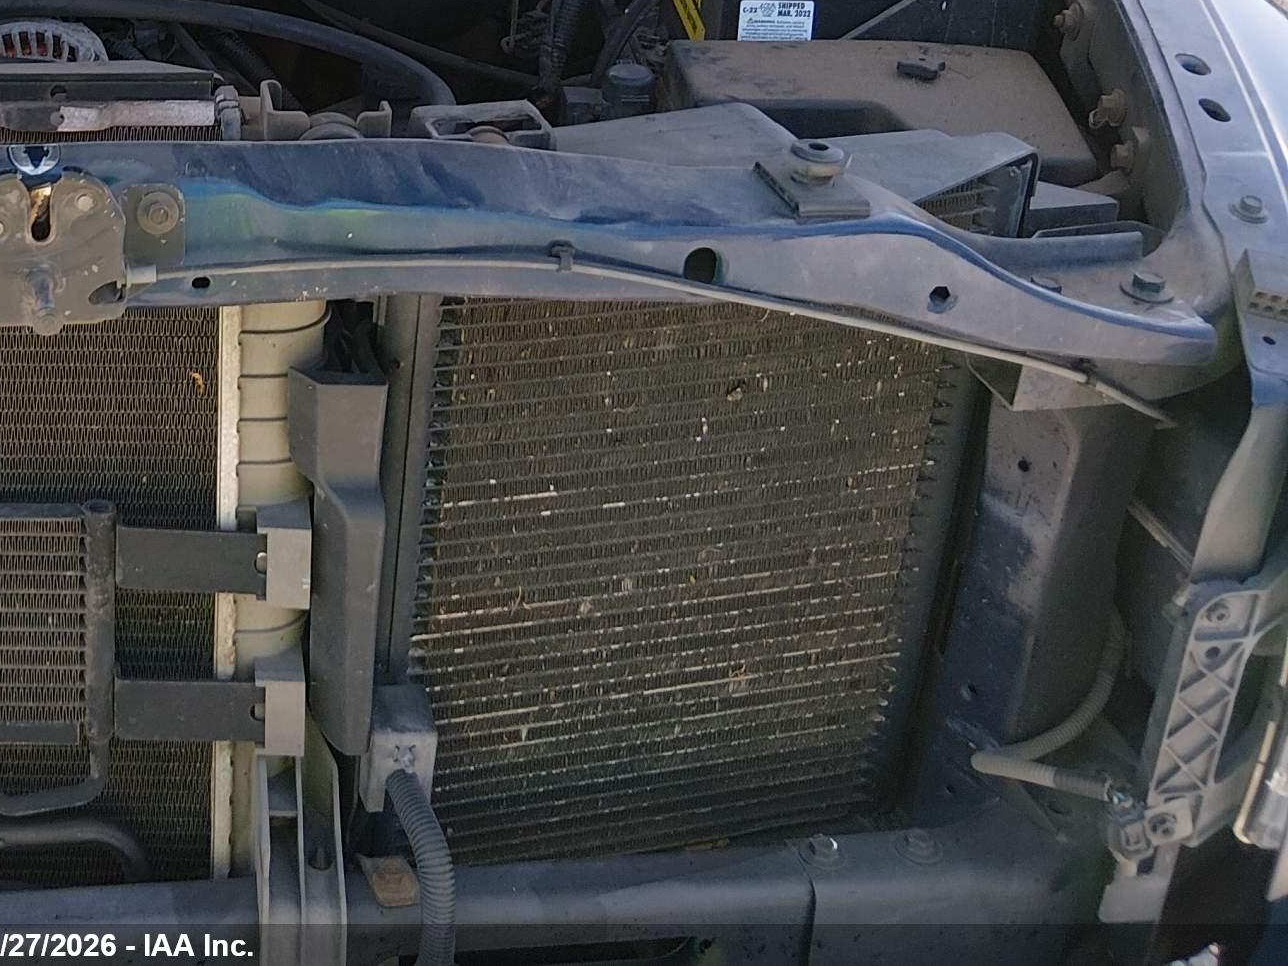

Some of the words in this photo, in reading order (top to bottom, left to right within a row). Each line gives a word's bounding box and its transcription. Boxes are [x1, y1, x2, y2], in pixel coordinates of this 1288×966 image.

[778, 1, 806, 10] SHIPPED
[777, 9, 793, 17] MAR.
[794, 9, 812, 18] 2022
